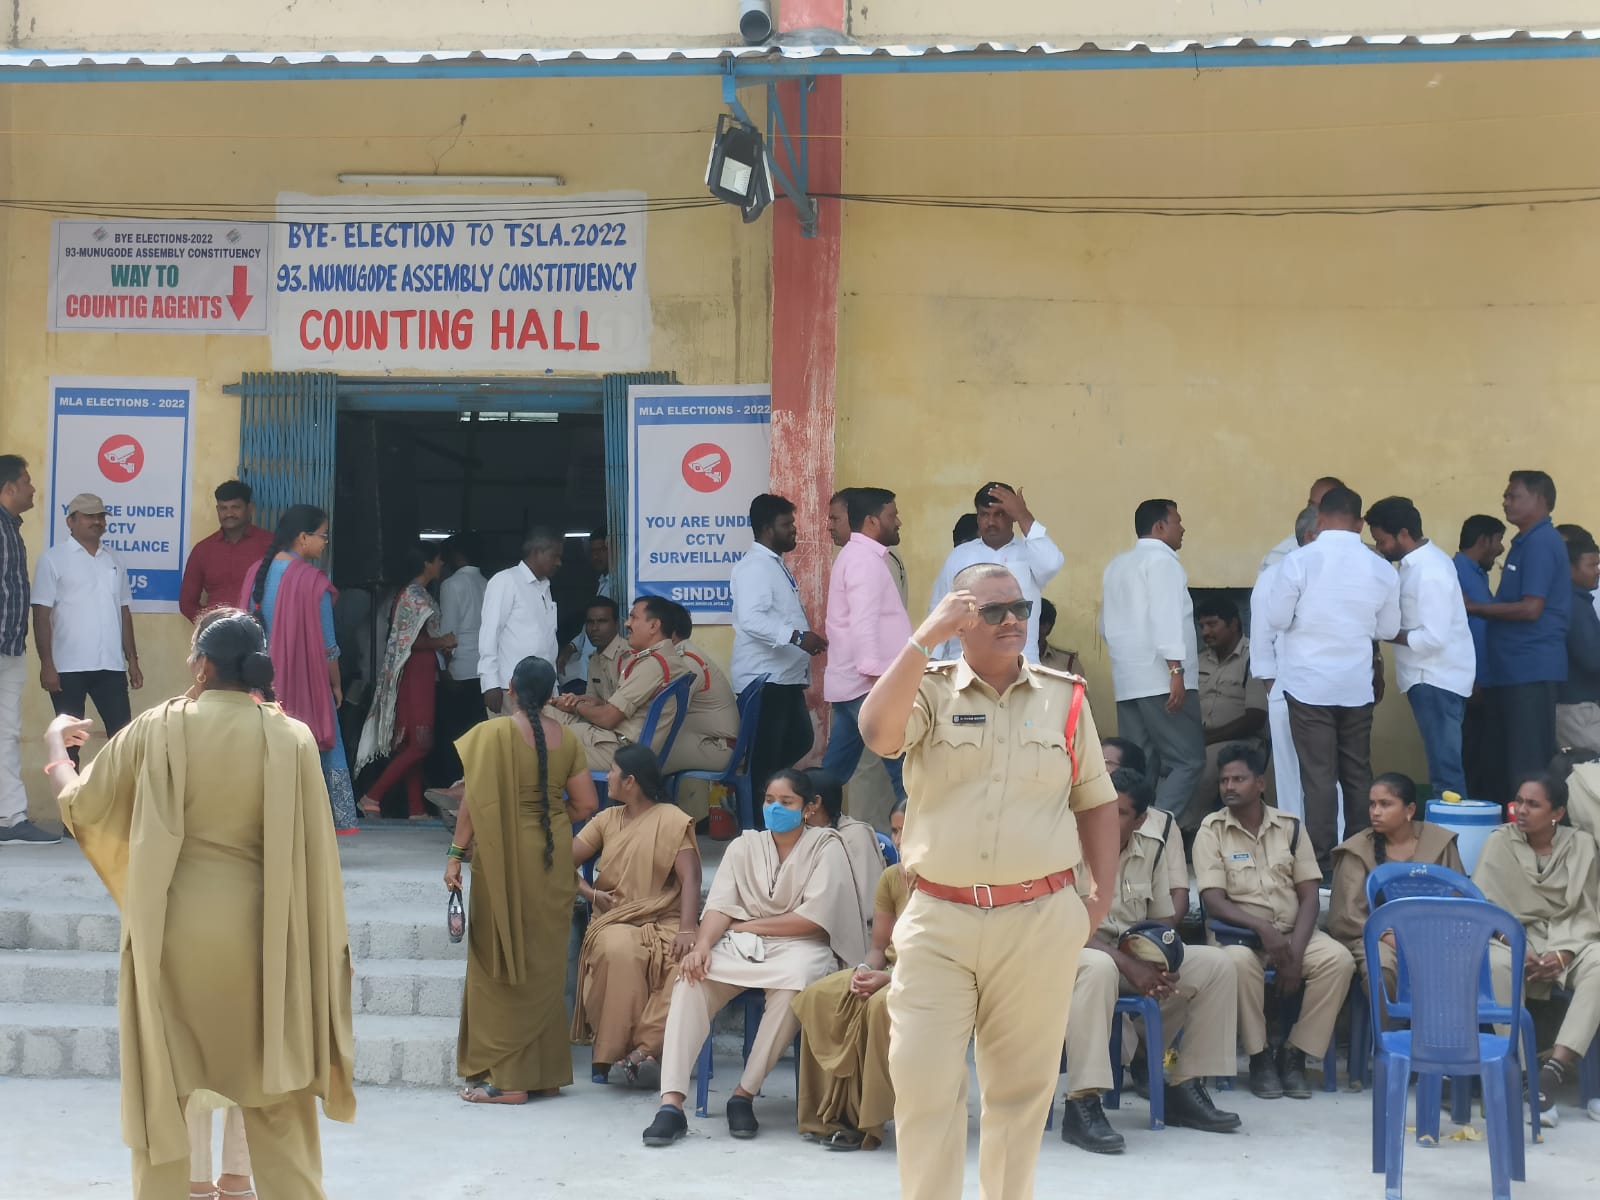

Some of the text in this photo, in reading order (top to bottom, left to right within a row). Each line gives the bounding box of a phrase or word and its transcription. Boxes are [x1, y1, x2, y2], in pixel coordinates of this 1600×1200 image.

[114, 233, 213, 244] BYE ELECTIONS-2022
[344, 222, 455, 248] ELECTION
[466, 222, 494, 247] TO
[65, 247, 261, 259] 93-MUNUGODE ASSEMBLY CONSTITUENCY
[111, 264, 180, 288] WAY TO
[401, 263, 494, 292] ASSEMBLY
[498, 262, 637, 292] CONSTITUENCY
[65, 294, 223, 320] COUNTIG AGENTS
[299, 308, 600, 351] COUNTING HALL
[60, 397, 83, 406] MLA
[86, 397, 150, 408] ELECTIONS
[158, 399, 185, 409] 2022
[639, 406, 664, 416] MLA
[667, 405, 734, 415] ELECTIONS
[743, 405, 770, 415] 2022
[126, 505, 174, 518] UNDER
[104, 522, 136, 534] CTV
[645, 516, 676, 529] YOU
[680, 515, 710, 528] ARE
[685, 533, 726, 546] CCTV
